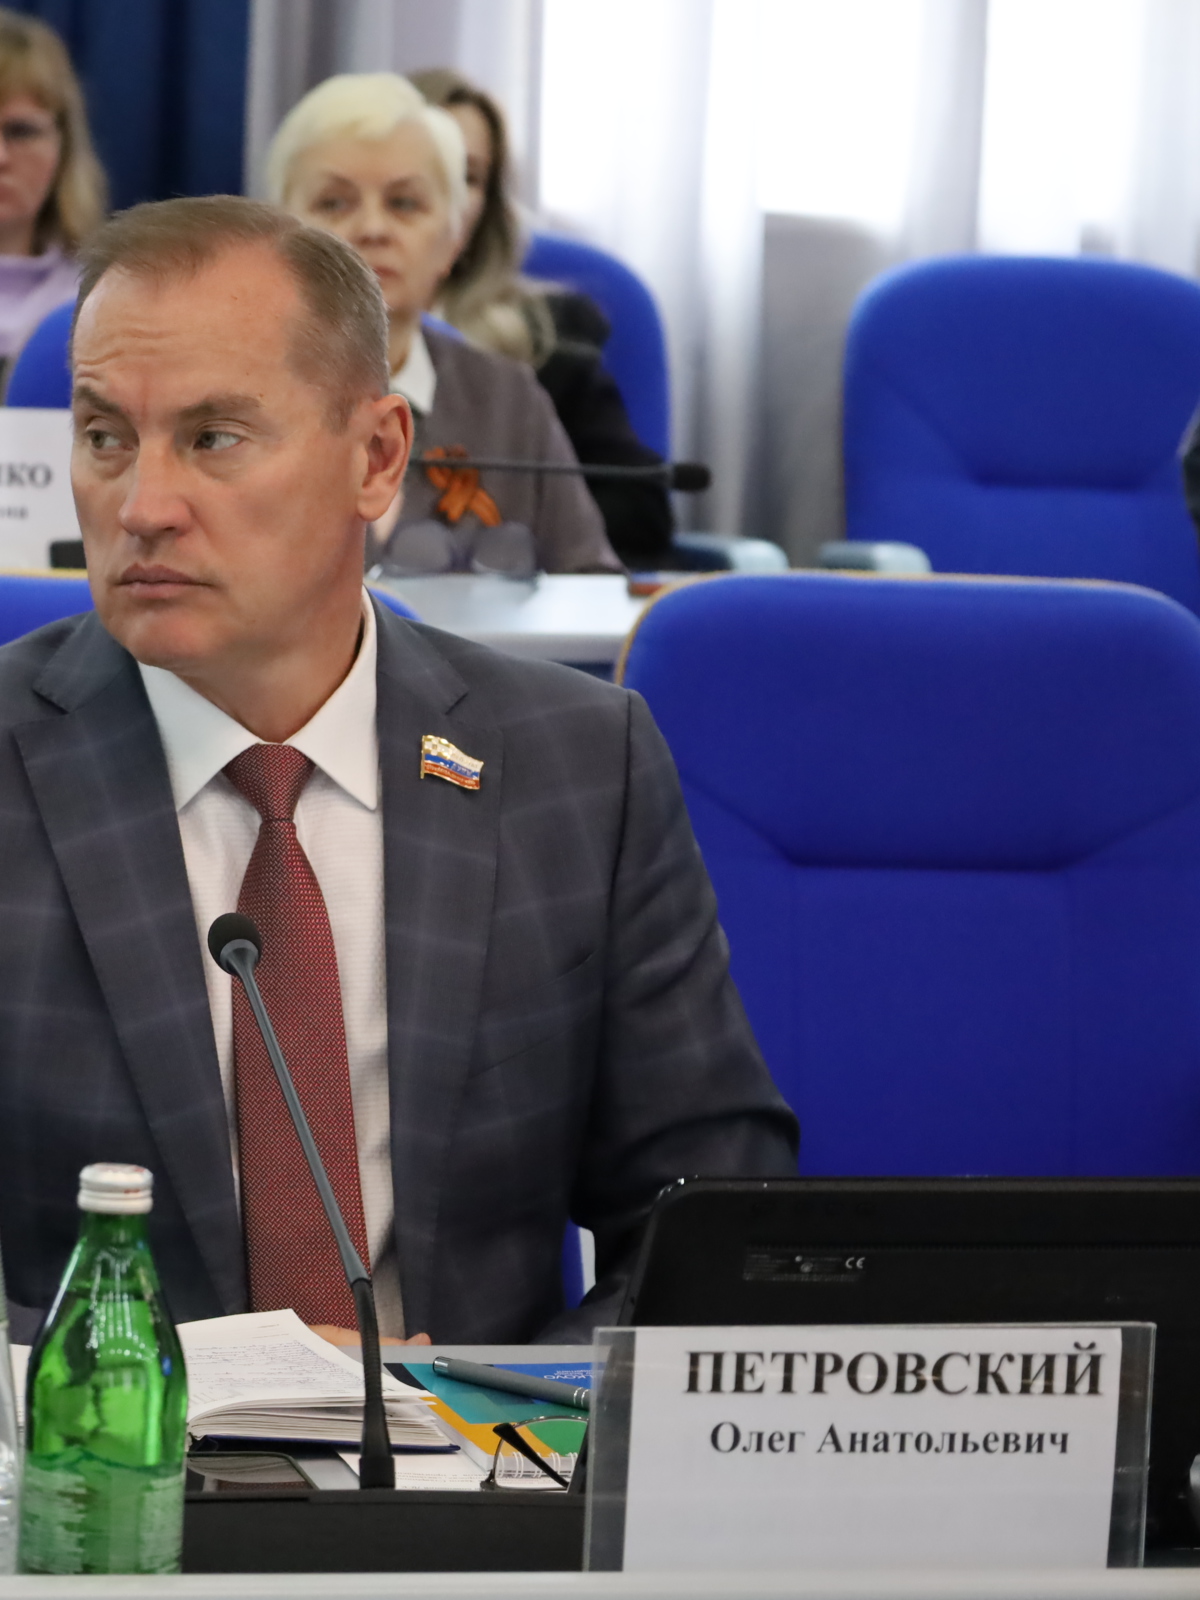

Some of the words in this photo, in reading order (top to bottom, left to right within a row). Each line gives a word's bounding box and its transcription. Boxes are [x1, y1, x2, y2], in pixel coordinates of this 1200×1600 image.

[684, 1341, 1104, 1396] ПЕТРОВСКИЙ
[710, 1421, 805, 1454] Олег
[816, 1423, 1070, 1455] Анатольевич
